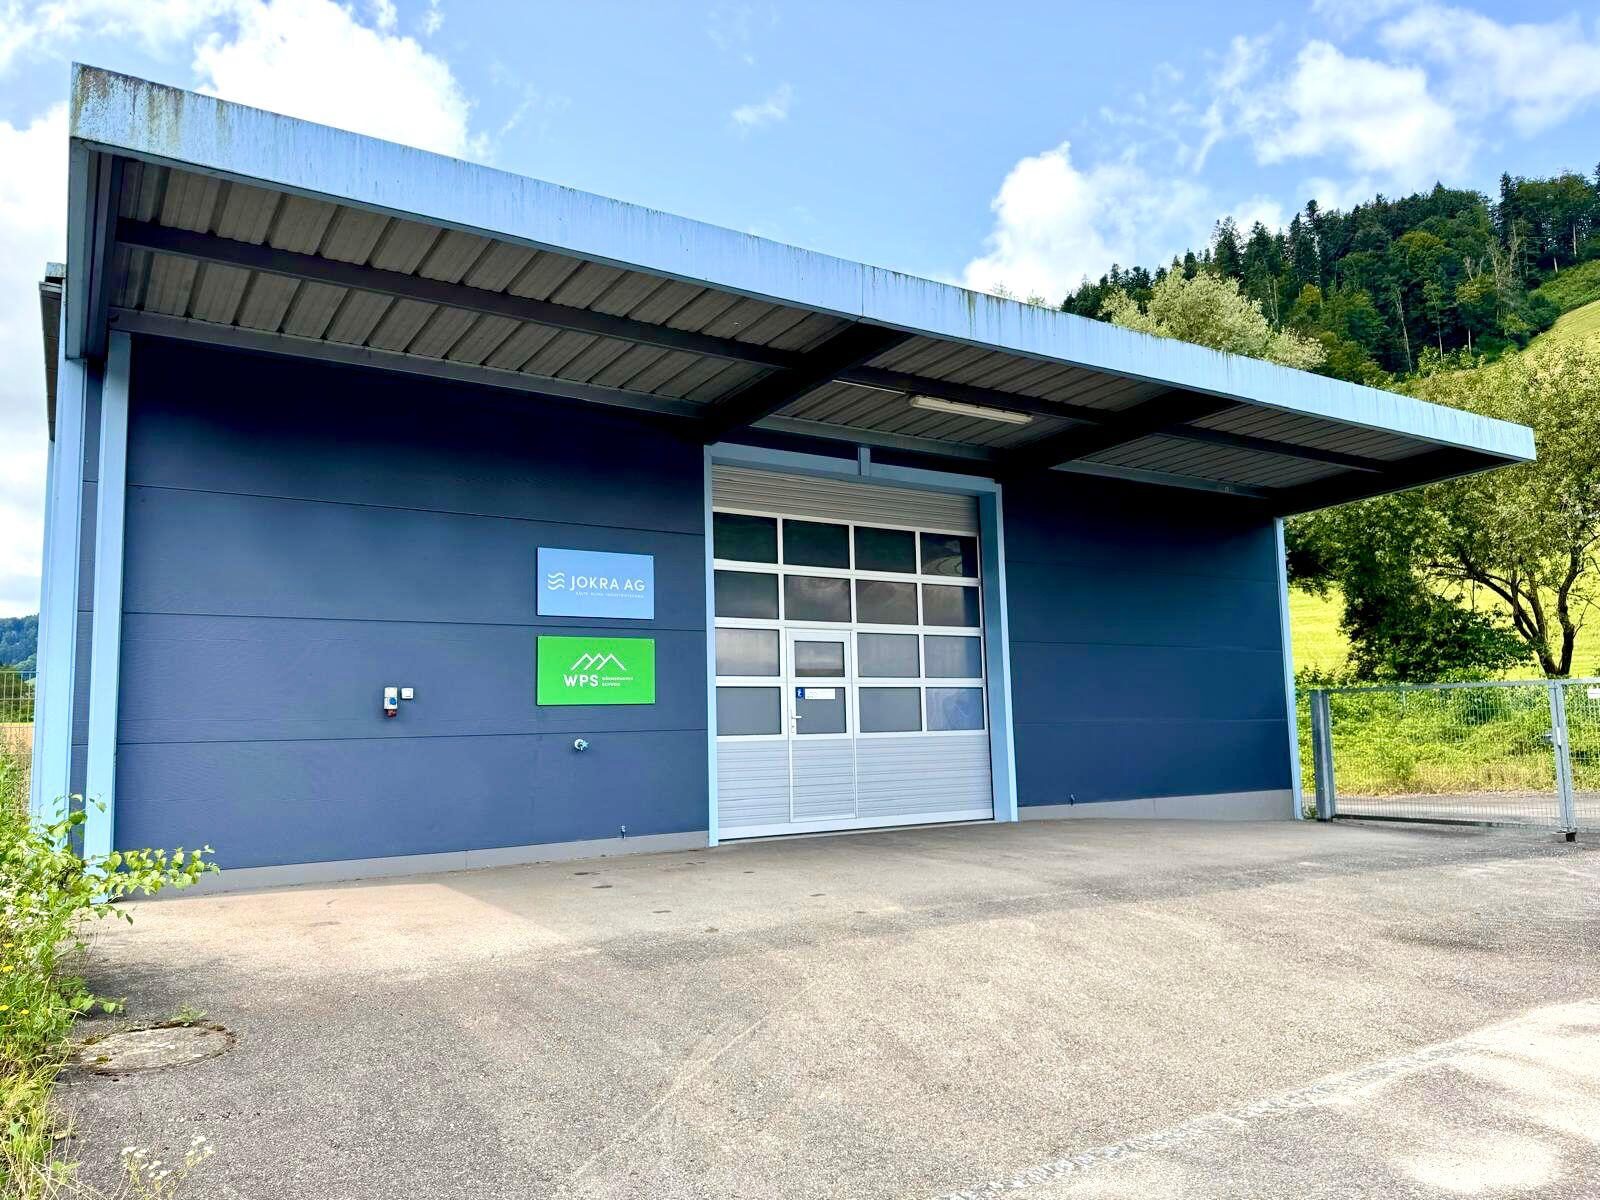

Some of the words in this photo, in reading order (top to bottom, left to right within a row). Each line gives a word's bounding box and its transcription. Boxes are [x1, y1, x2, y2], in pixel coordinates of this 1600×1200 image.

[569, 576, 619, 591] JOKRA
[623, 578, 645, 592] AG
[563, 674, 599, 687] WPS
